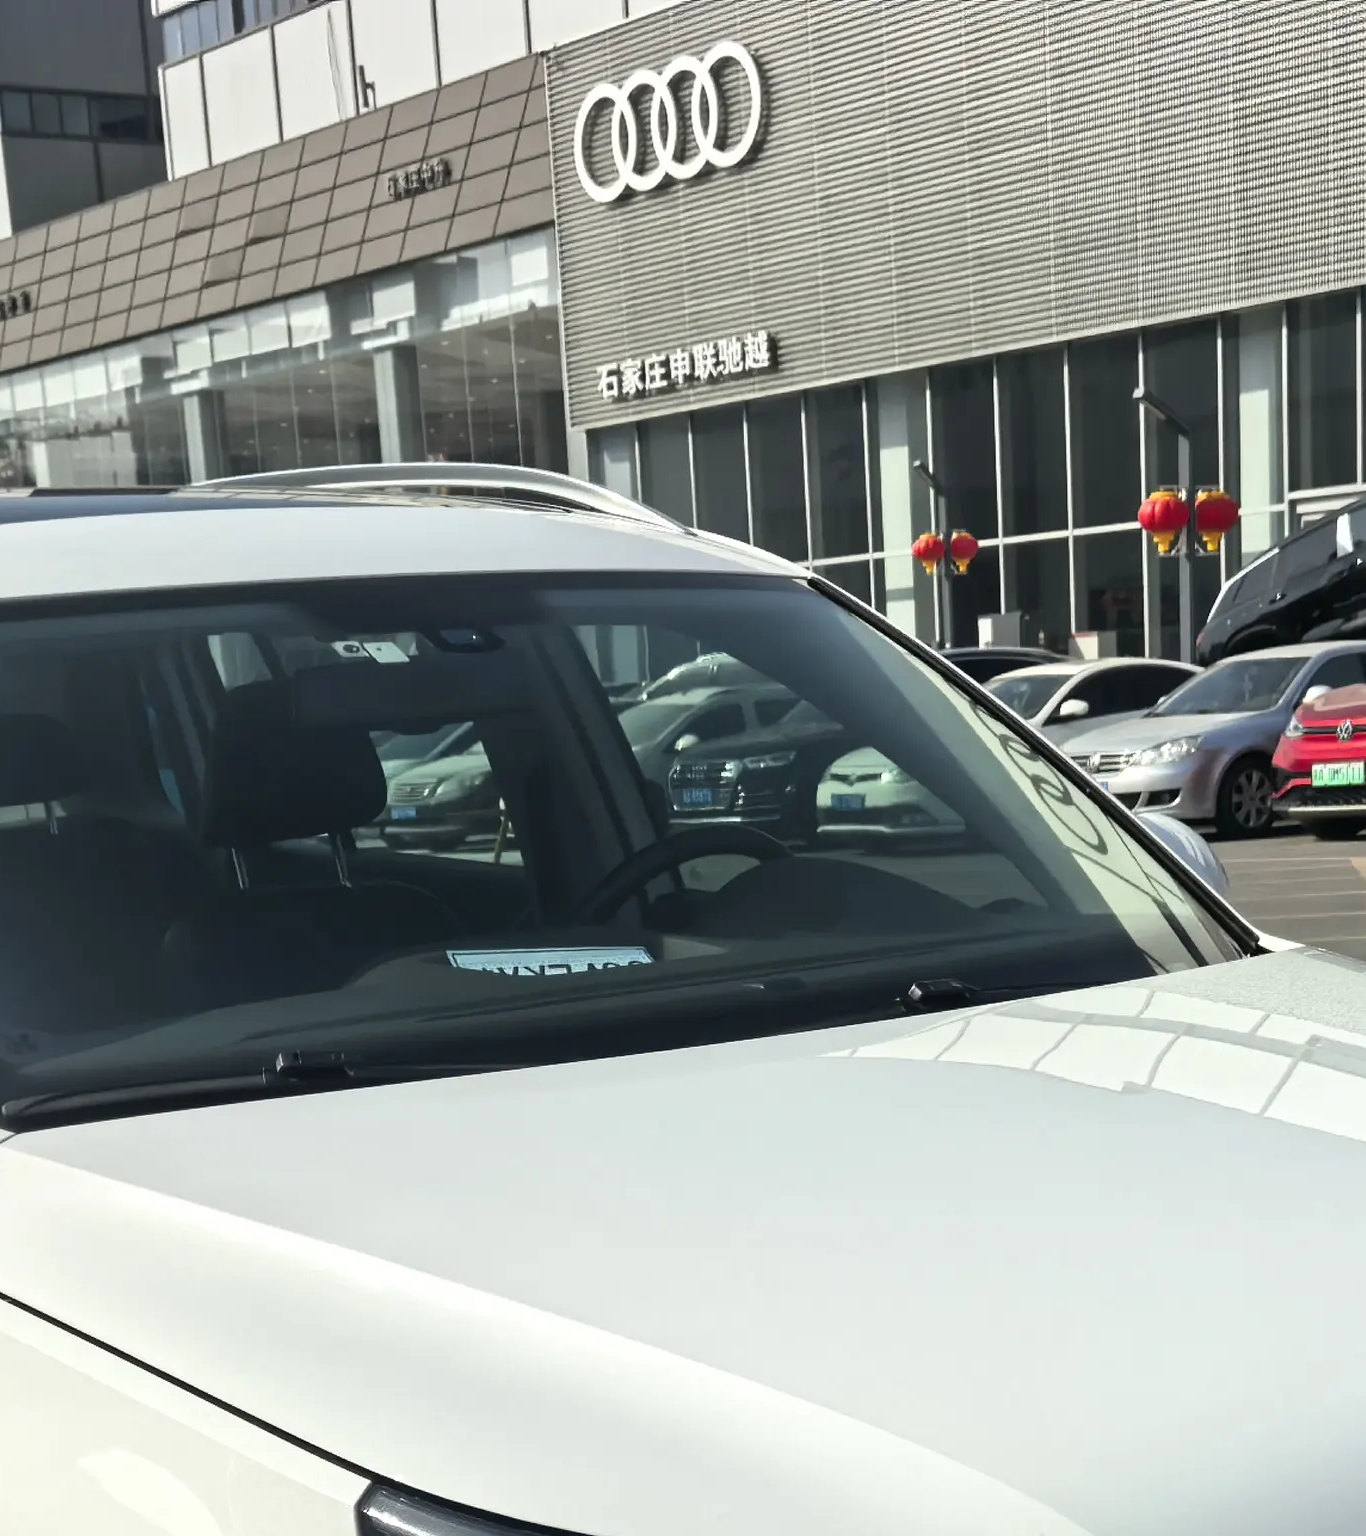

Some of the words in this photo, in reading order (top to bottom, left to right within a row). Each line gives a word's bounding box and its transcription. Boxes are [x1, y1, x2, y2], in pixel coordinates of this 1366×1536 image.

[596, 331, 769, 398] 石家庄申联驰越
